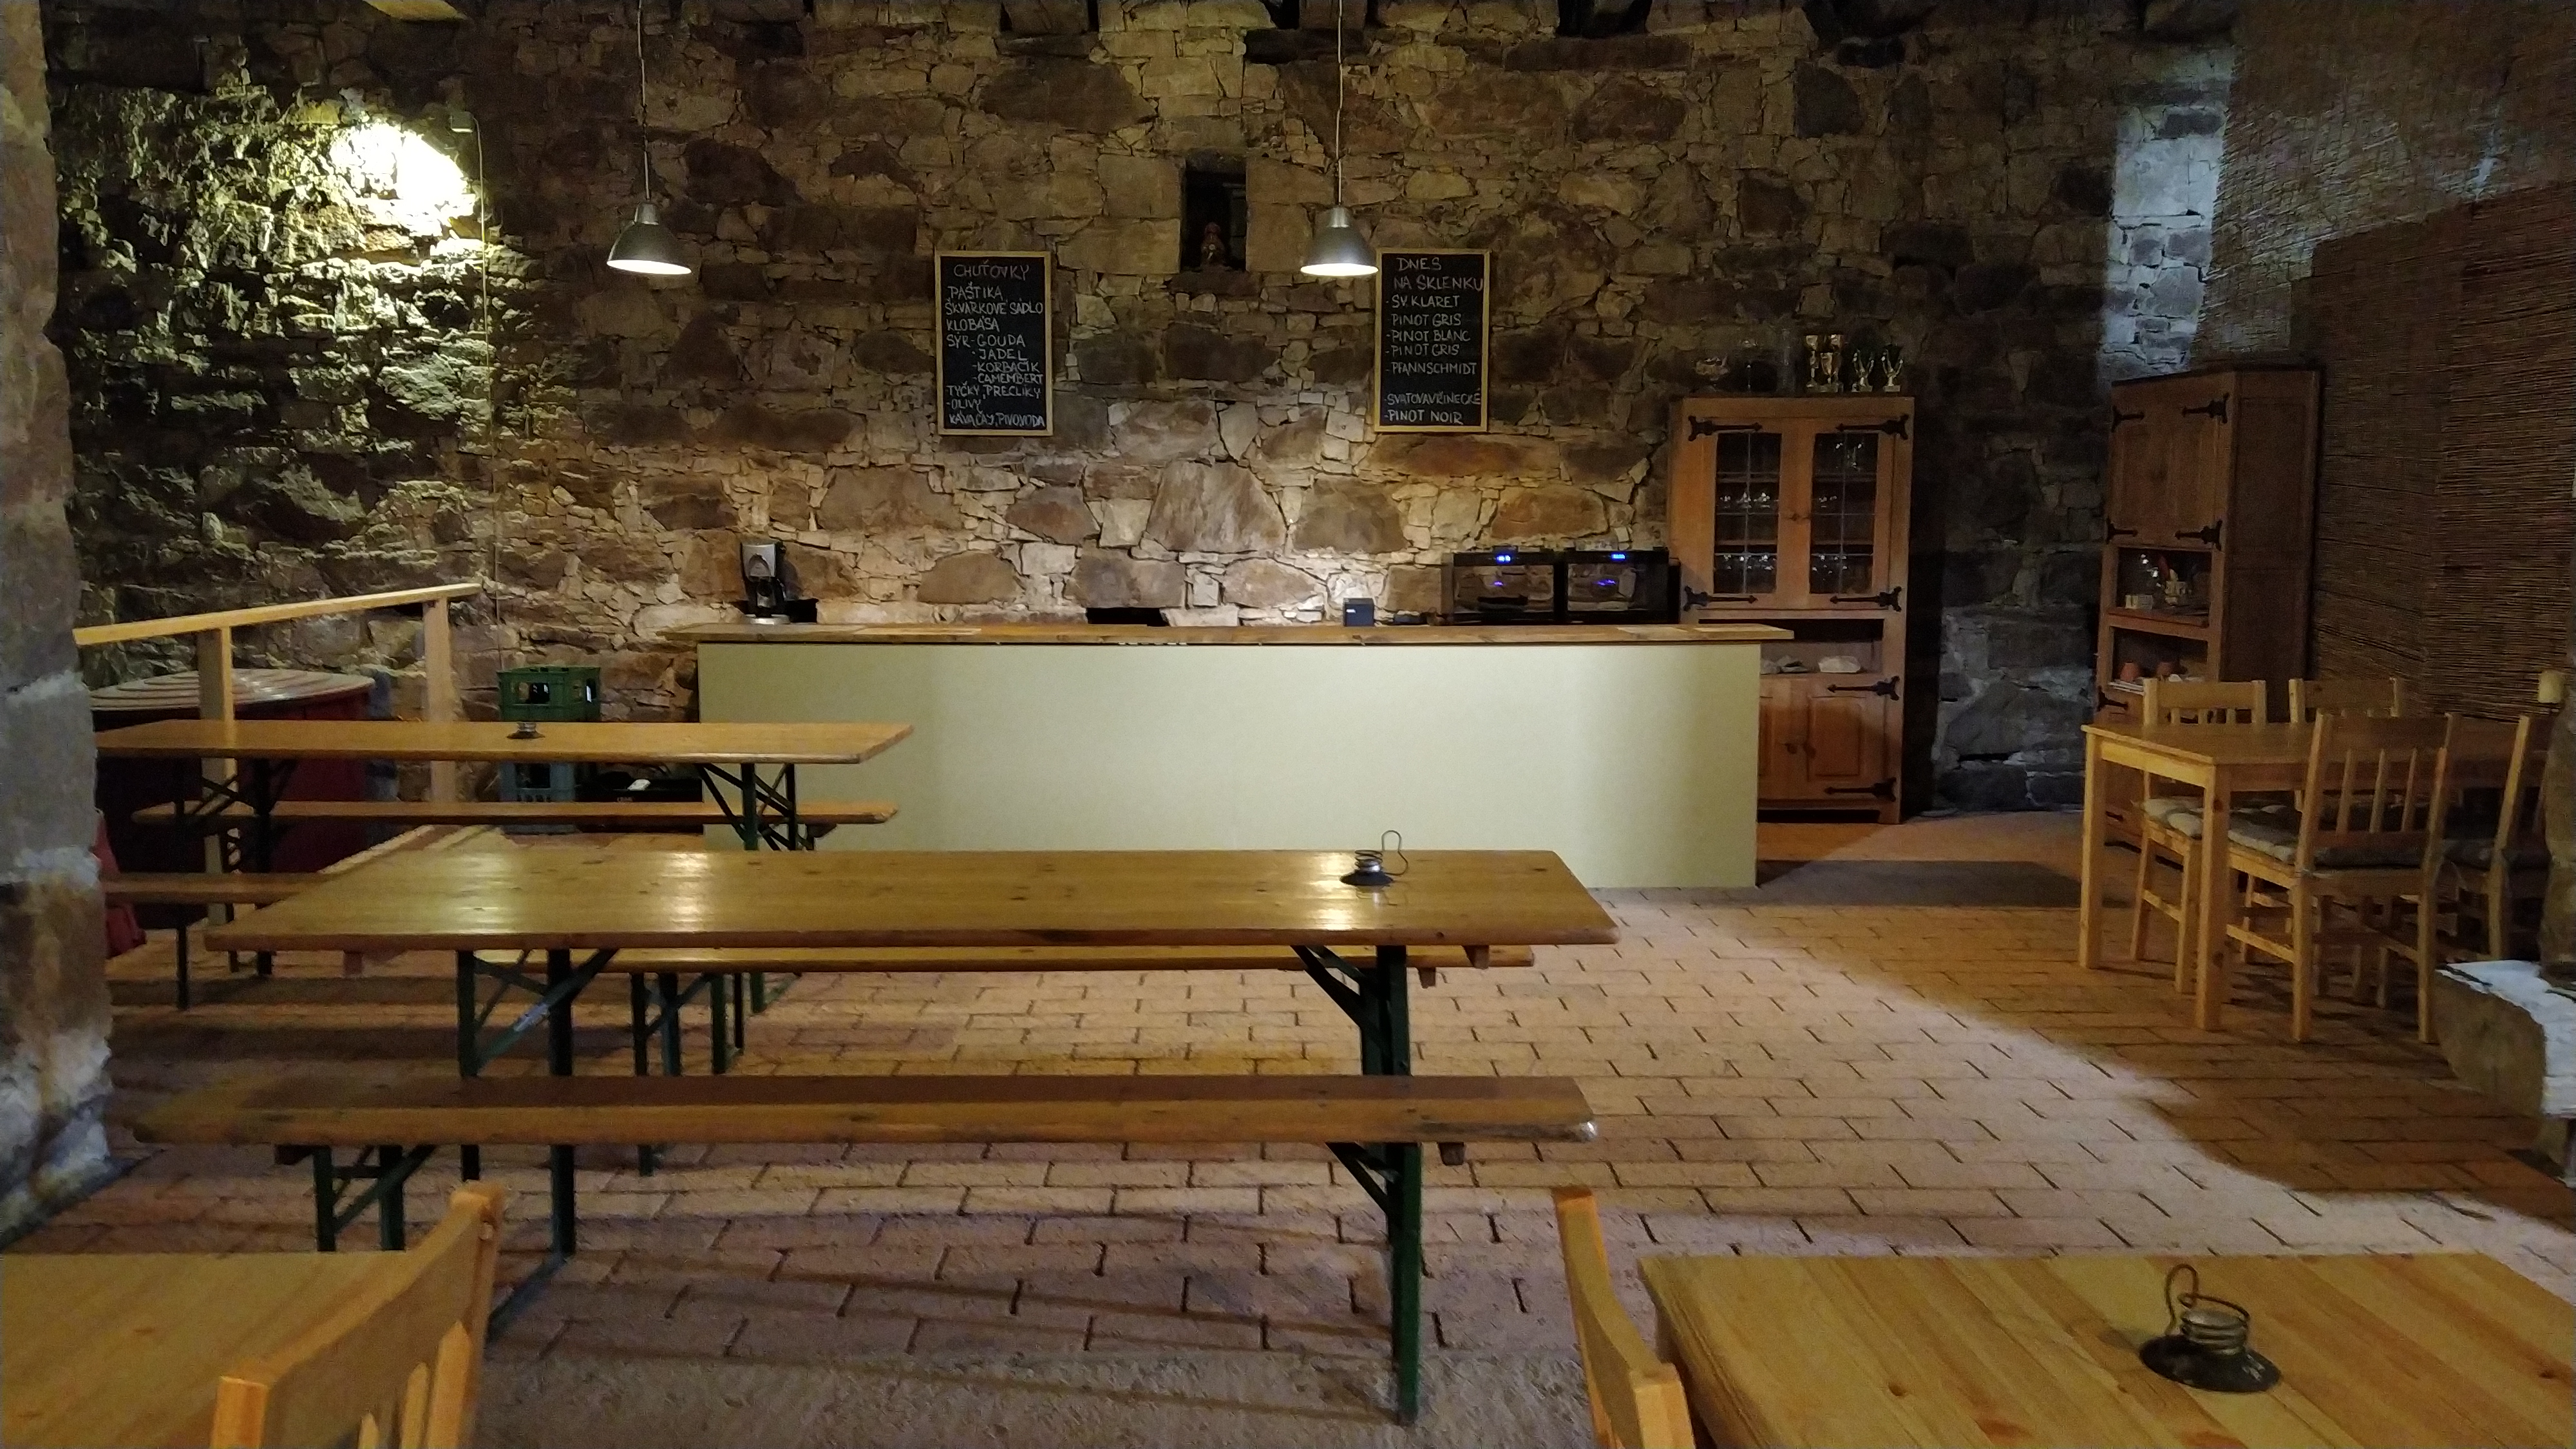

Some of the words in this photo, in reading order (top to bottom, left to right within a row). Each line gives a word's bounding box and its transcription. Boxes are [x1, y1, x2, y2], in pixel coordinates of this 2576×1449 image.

[1396, 258, 1442, 271] DNES
[1393, 276, 1412, 290] NA
[1416, 274, 1483, 292] SKLENKU
[947, 281, 1003, 301] PAŠTIKA
[1009, 298, 1043, 314] SÁDLO
[1411, 295, 1460, 308] KLARET
[946, 316, 1000, 332] KLOBÁSA
[1391, 313, 1429, 326] PINOT
[1432, 313, 1462, 327] GRIS
[1433, 329, 1471, 342] BLANC
[978, 348, 1028, 361] JADEL
[1432, 344, 1459, 356] GRIS
[1430, 410, 1464, 426] NOIR
